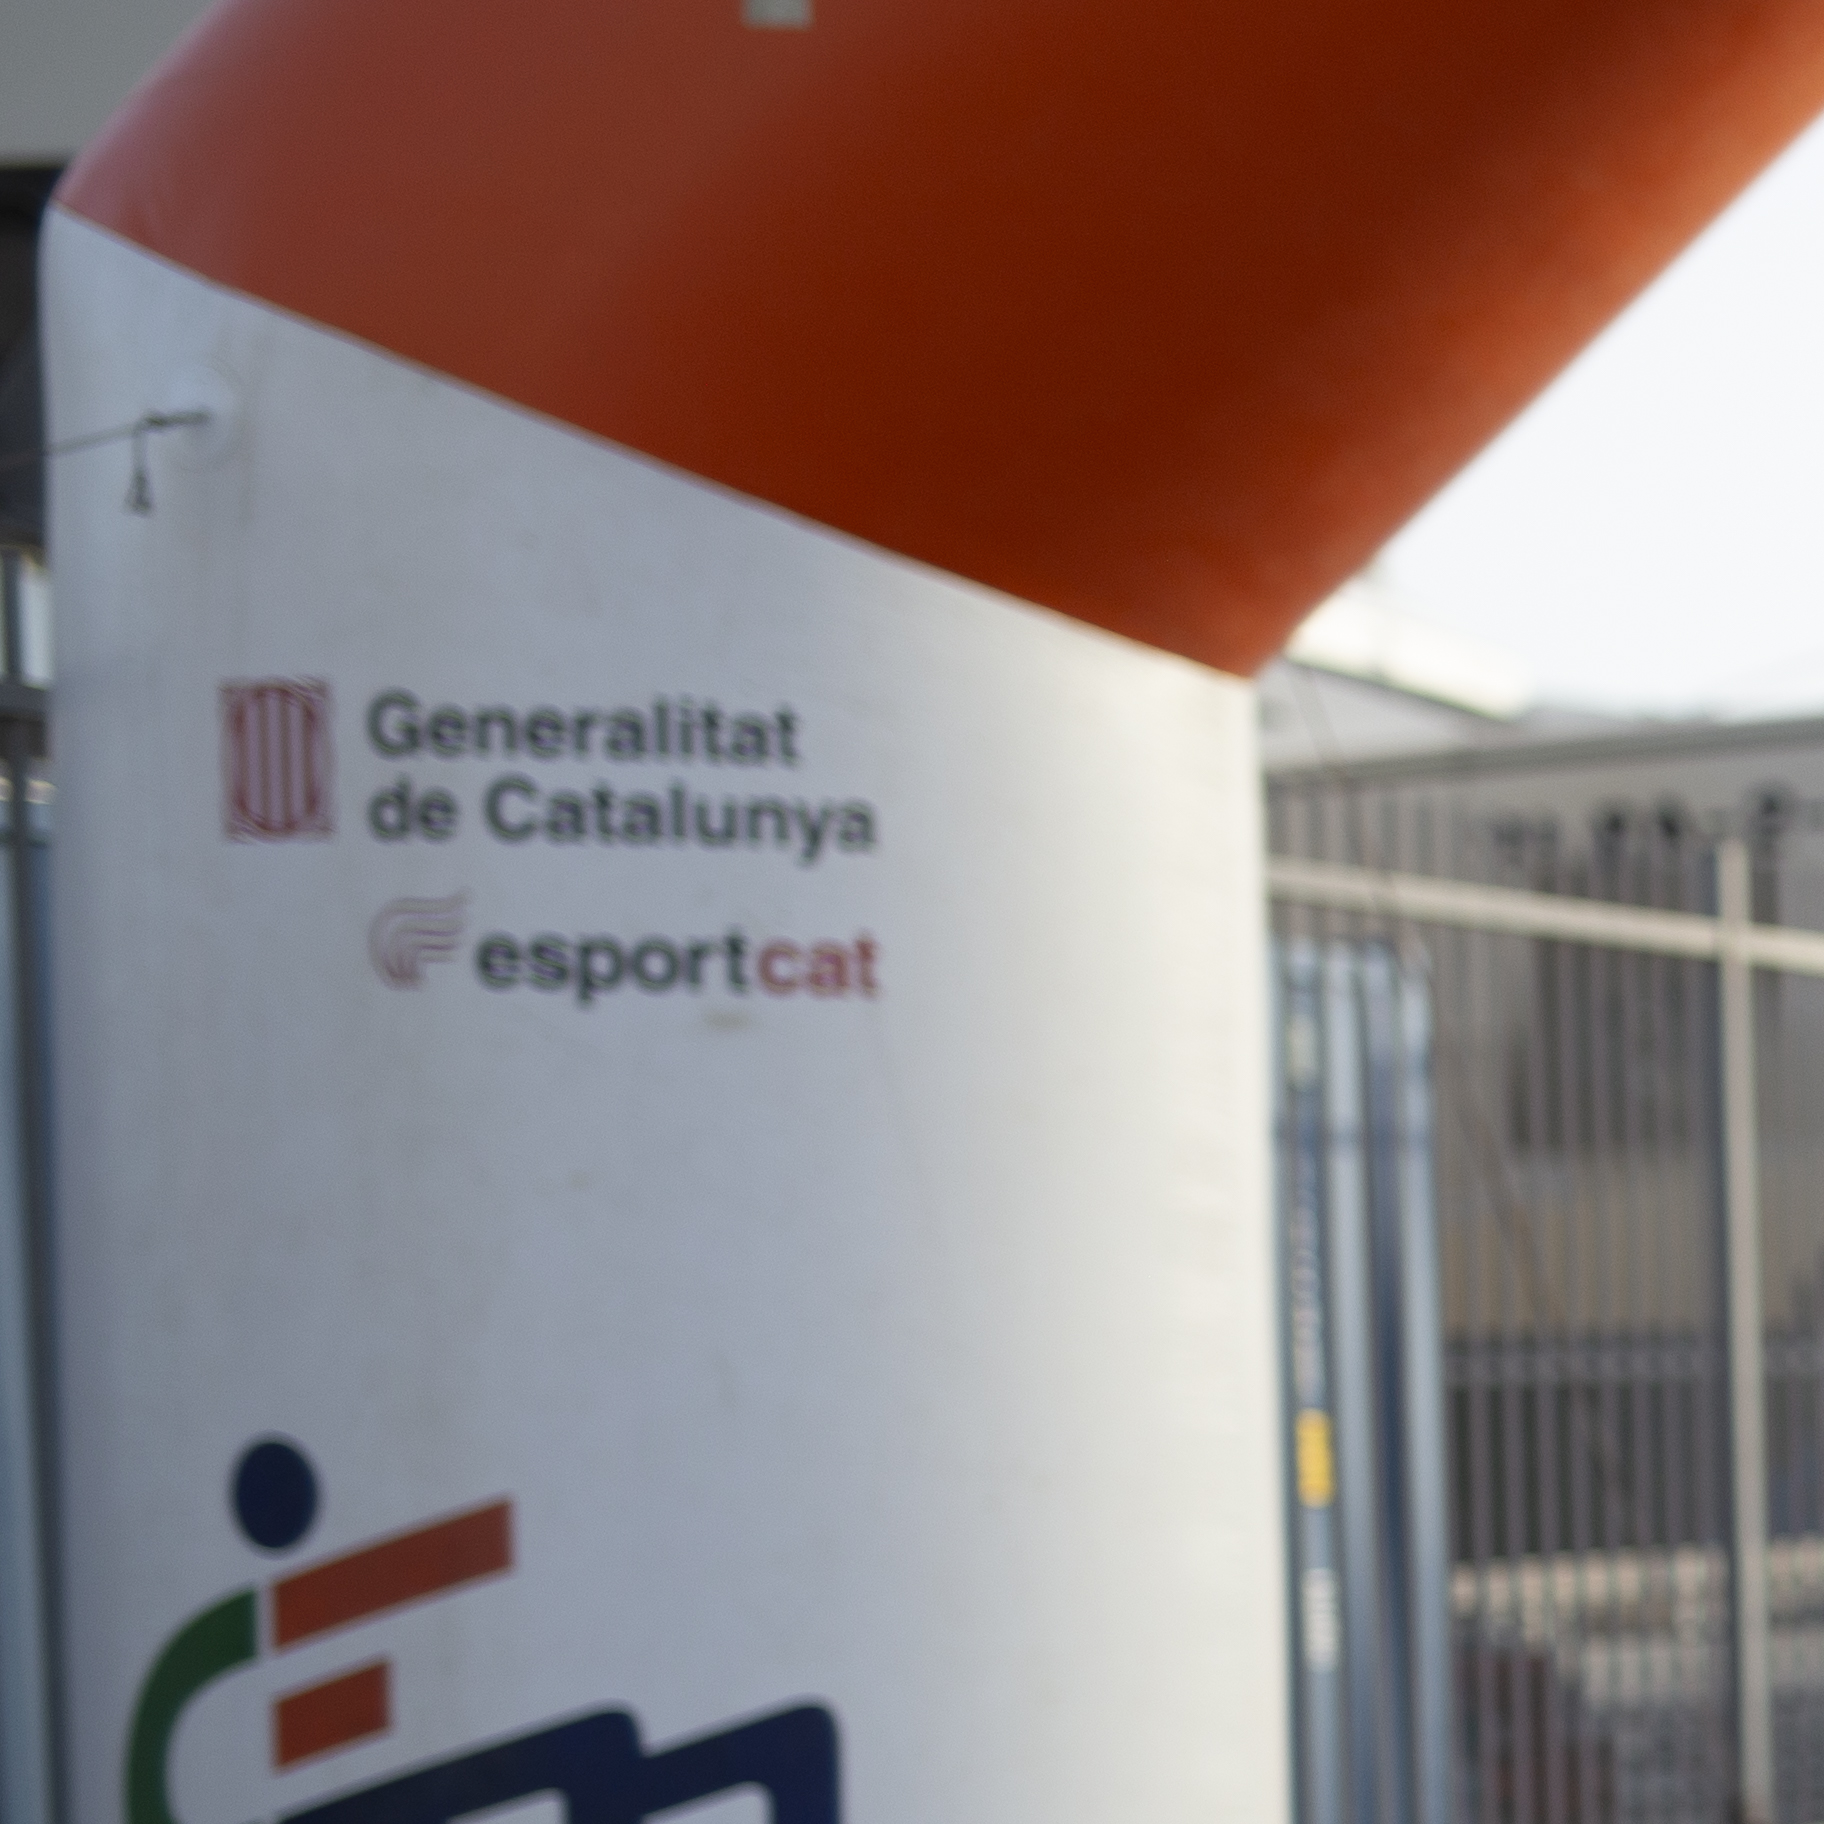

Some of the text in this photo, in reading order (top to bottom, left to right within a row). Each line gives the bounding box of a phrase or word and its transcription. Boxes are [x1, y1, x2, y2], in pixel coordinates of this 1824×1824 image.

[367, 689, 799, 764] Generalitat
[367, 773, 877, 867] de Catalunya
[475, 925, 879, 1007] esportcat
